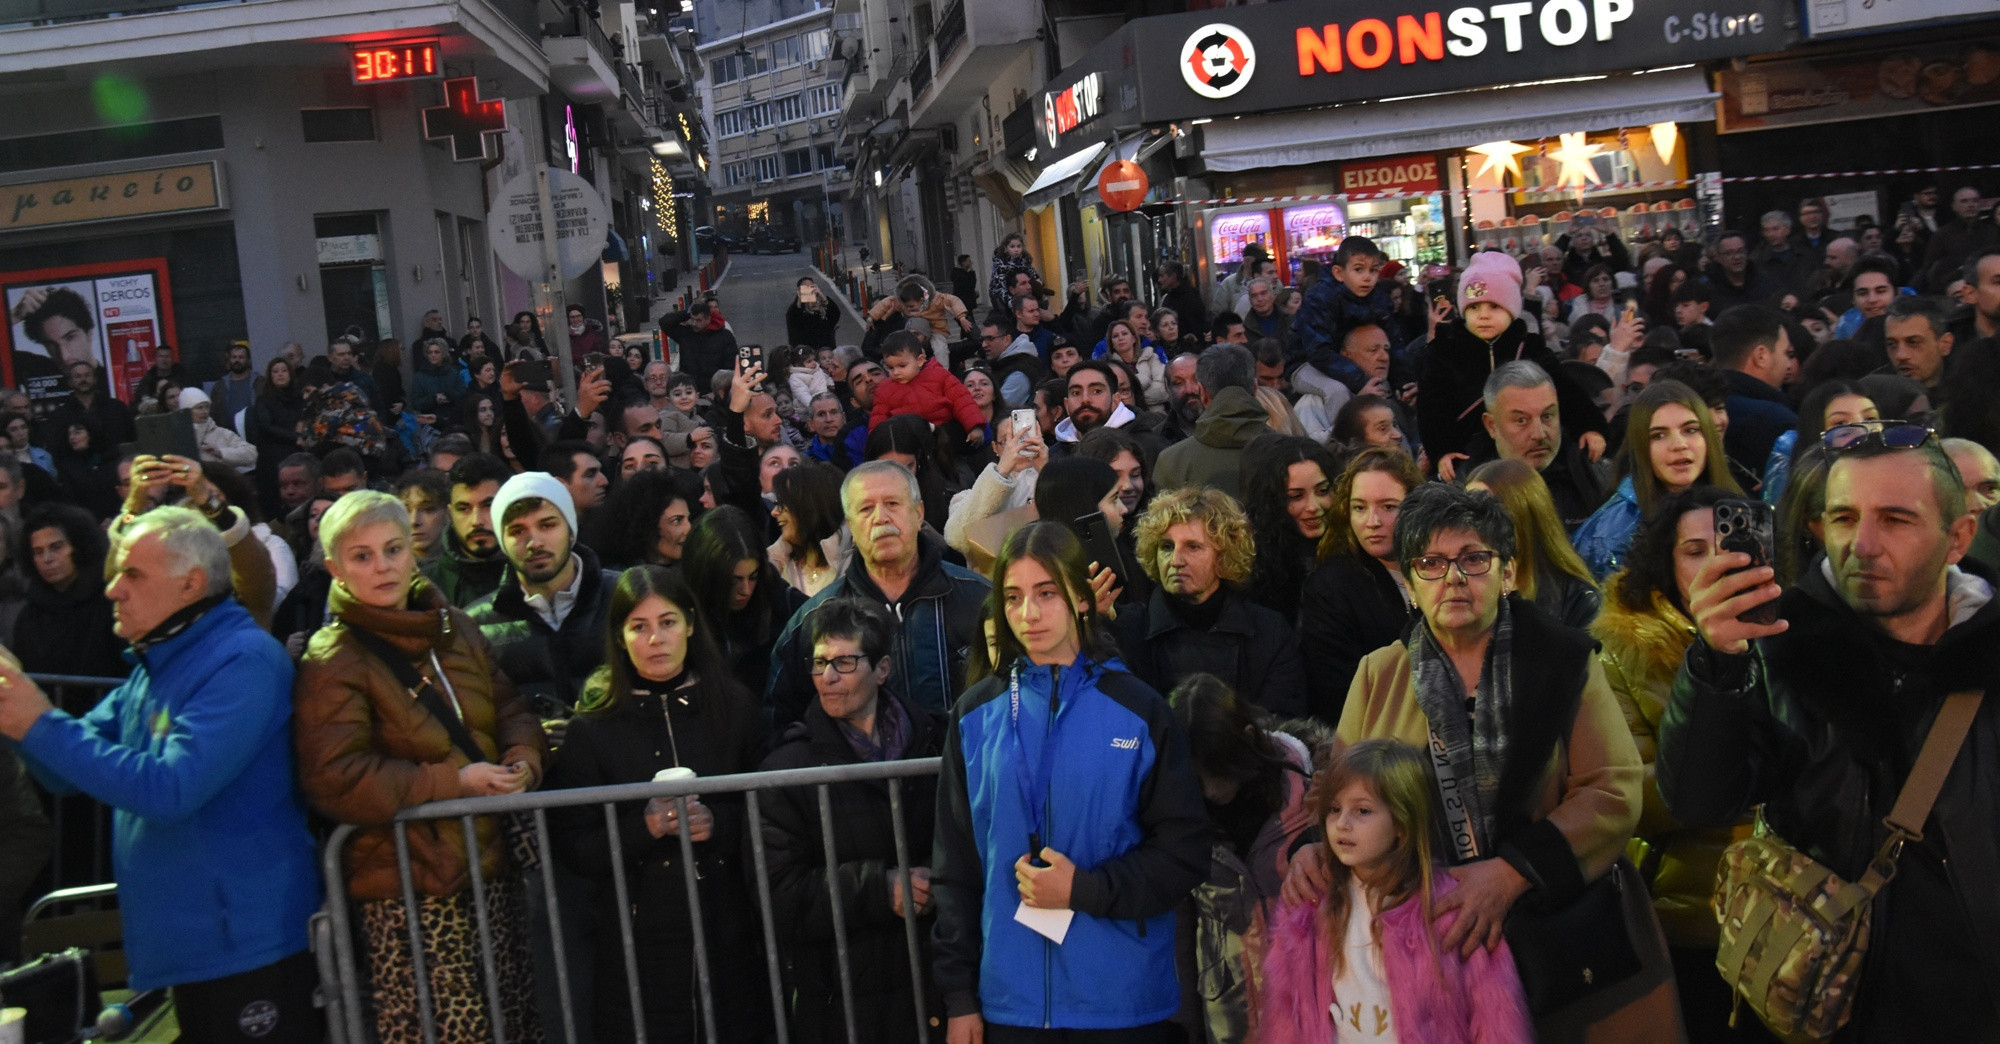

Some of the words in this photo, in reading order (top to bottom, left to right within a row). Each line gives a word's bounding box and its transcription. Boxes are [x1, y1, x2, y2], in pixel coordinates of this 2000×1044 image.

[1295, 0, 1634, 77] NONSTOP
[1663, 11, 1765, 44] C-Store
[355, 47, 433, 81] 30:11
[1343, 161, 1438, 189] ΕΙΣΟΔΟΣ
[101, 287, 150, 302] DERCOS
[110, 278, 138, 288] VICHY
